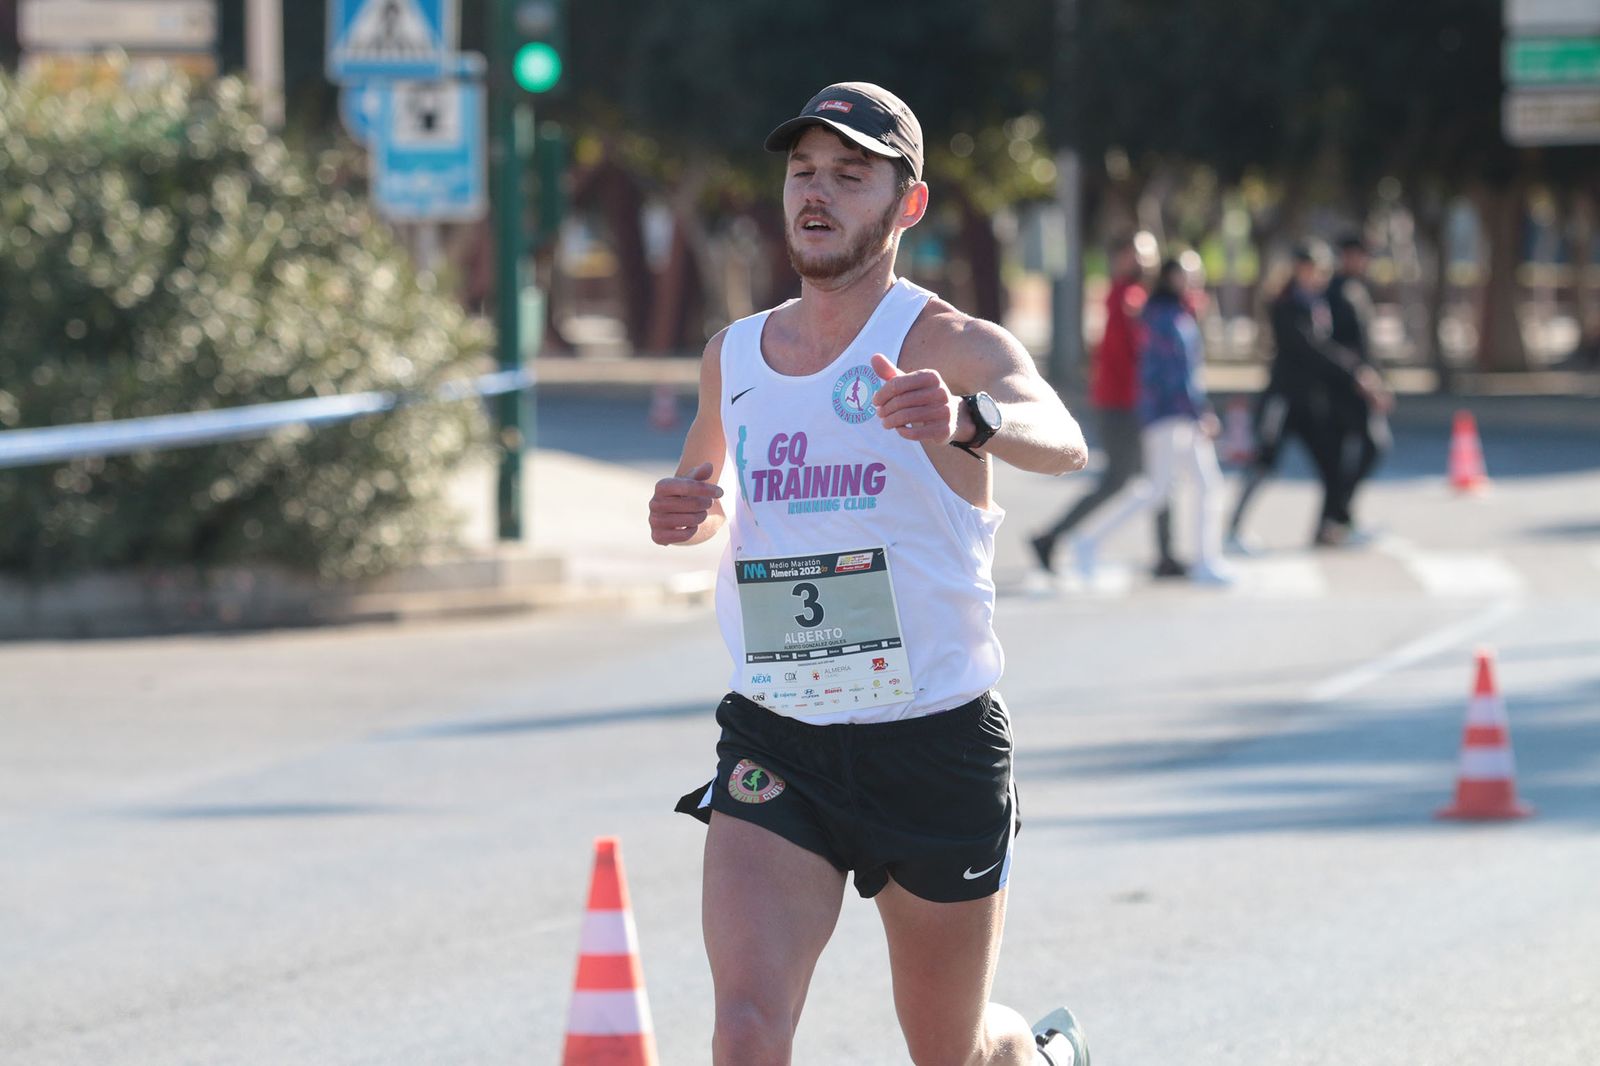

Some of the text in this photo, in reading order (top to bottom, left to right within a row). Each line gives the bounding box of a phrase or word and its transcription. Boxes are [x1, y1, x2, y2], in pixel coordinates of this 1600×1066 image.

[843, 366, 879, 385] TRAINING
[832, 398, 867, 424] RUNNING
[768, 431, 808, 468] GQ
[752, 462, 886, 503] TRAINING
[788, 496, 877, 515] RUNNING CLUB
[769, 558, 821, 569] Medio Maratón
[770, 567, 799, 578] Almería
[799, 565, 821, 576] 2022
[792, 582, 824, 628] 3
[784, 627, 843, 644] ALBERTO
[751, 674, 771, 684] NEXA
[762, 784, 784, 801] CLUB
